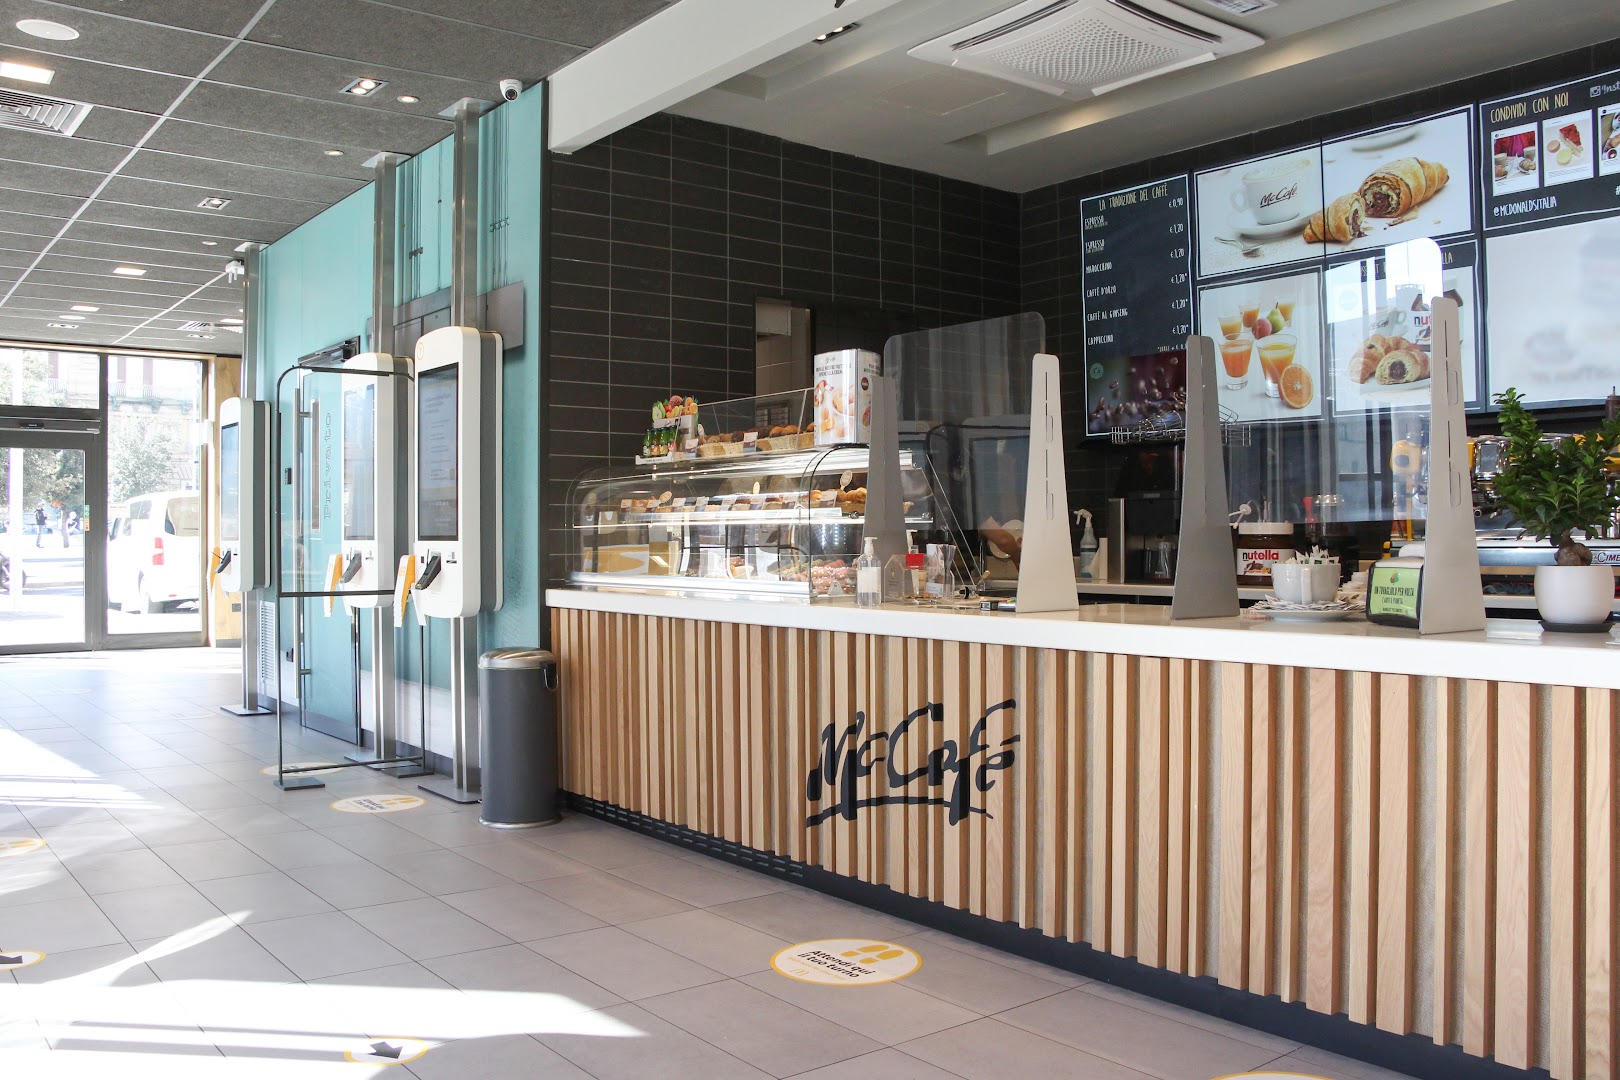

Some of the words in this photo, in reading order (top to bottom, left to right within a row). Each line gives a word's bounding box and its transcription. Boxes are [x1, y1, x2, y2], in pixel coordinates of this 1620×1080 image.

[1490, 101, 1527, 123] CONDIVIDI
[1532, 97, 1549, 114] CON
[1554, 91, 1569, 109] NOI
[1099, 199, 1106, 212] LA
[1109, 191, 1137, 208] TRADIZIONE
[1139, 189, 1149, 202] DEL
[1152, 183, 1168, 199] CAFFÈ
[1493, 195, 1557, 217] @MCDONALDSITALIA
[1084, 215, 1105, 227] ESPRESSO
[1085, 238, 1105, 251] ESPRESSO
[1085, 261, 1113, 274] MAROCCHINO
[1086, 286, 1100, 298] CAFFÈ
[1087, 310, 1100, 322] CAFFÈ
[1101, 311, 1108, 320] AL
[1109, 307, 1128, 319] GINSENG
[1087, 334, 1114, 346] CAPPUCCINO
[1242, 550, 1279, 560] nutella
[807, 698, 1020, 829] McCafé
[807, 956, 827, 965] tuo
[826, 964, 860, 978] turno
[808, 950, 857, 967] Attendi
[851, 966, 876, 975] qui
